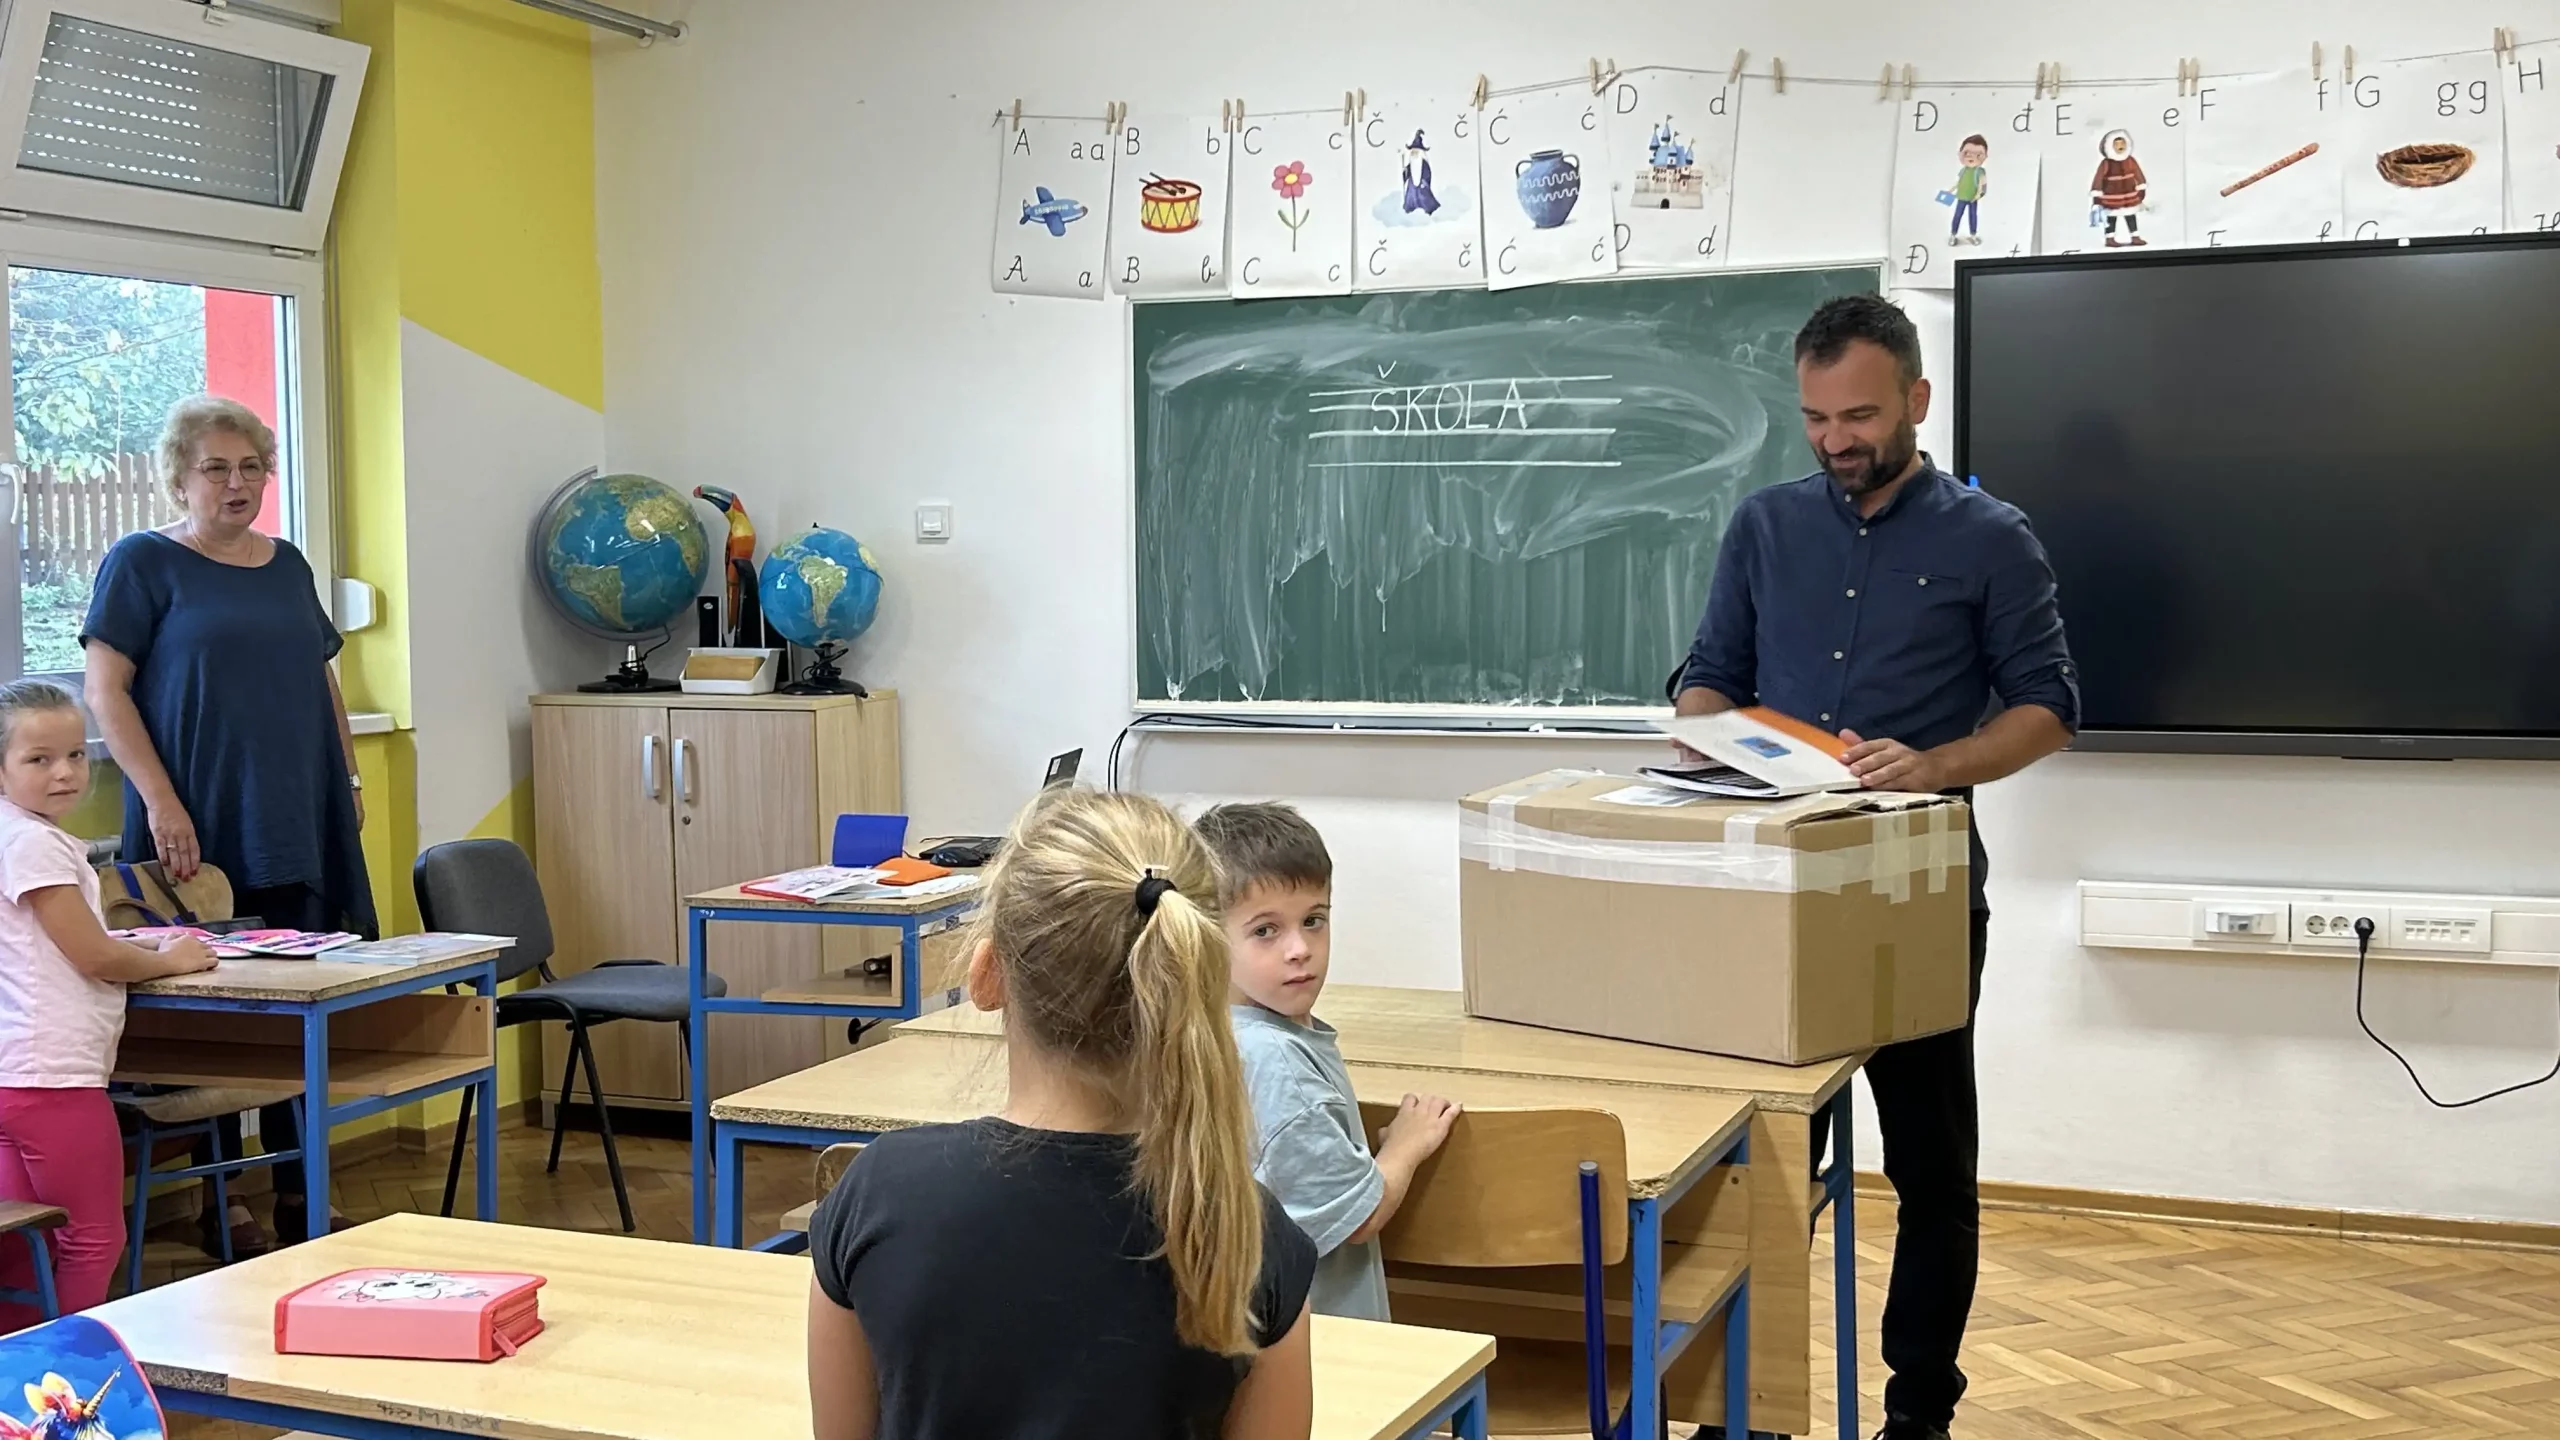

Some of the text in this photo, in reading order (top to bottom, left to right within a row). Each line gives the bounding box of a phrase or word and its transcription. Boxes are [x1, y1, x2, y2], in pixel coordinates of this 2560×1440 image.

[2354, 75, 2381, 109] G
[2517, 57, 2544, 94] H
[1616, 83, 1727, 116] D d
[2200, 78, 2329, 121] F f
[1365, 111, 1469, 148] Č č
[1489, 105, 1596, 146] Ć ć
[2055, 103, 2180, 136] E e
[1013, 128, 1031, 157] A
[1126, 126, 1221, 156] B b
[1243, 126, 1343, 156] C c
[1498, 235, 1605, 275] Ć ć
[1697, 224, 1718, 255] d
[1002, 254, 1094, 289] A a
[1121, 255, 1140, 284] B
[1242, 256, 1341, 286] C c
[1368, 238, 1472, 277] Č č
[1371, 360, 1529, 436] ŠKOLA
